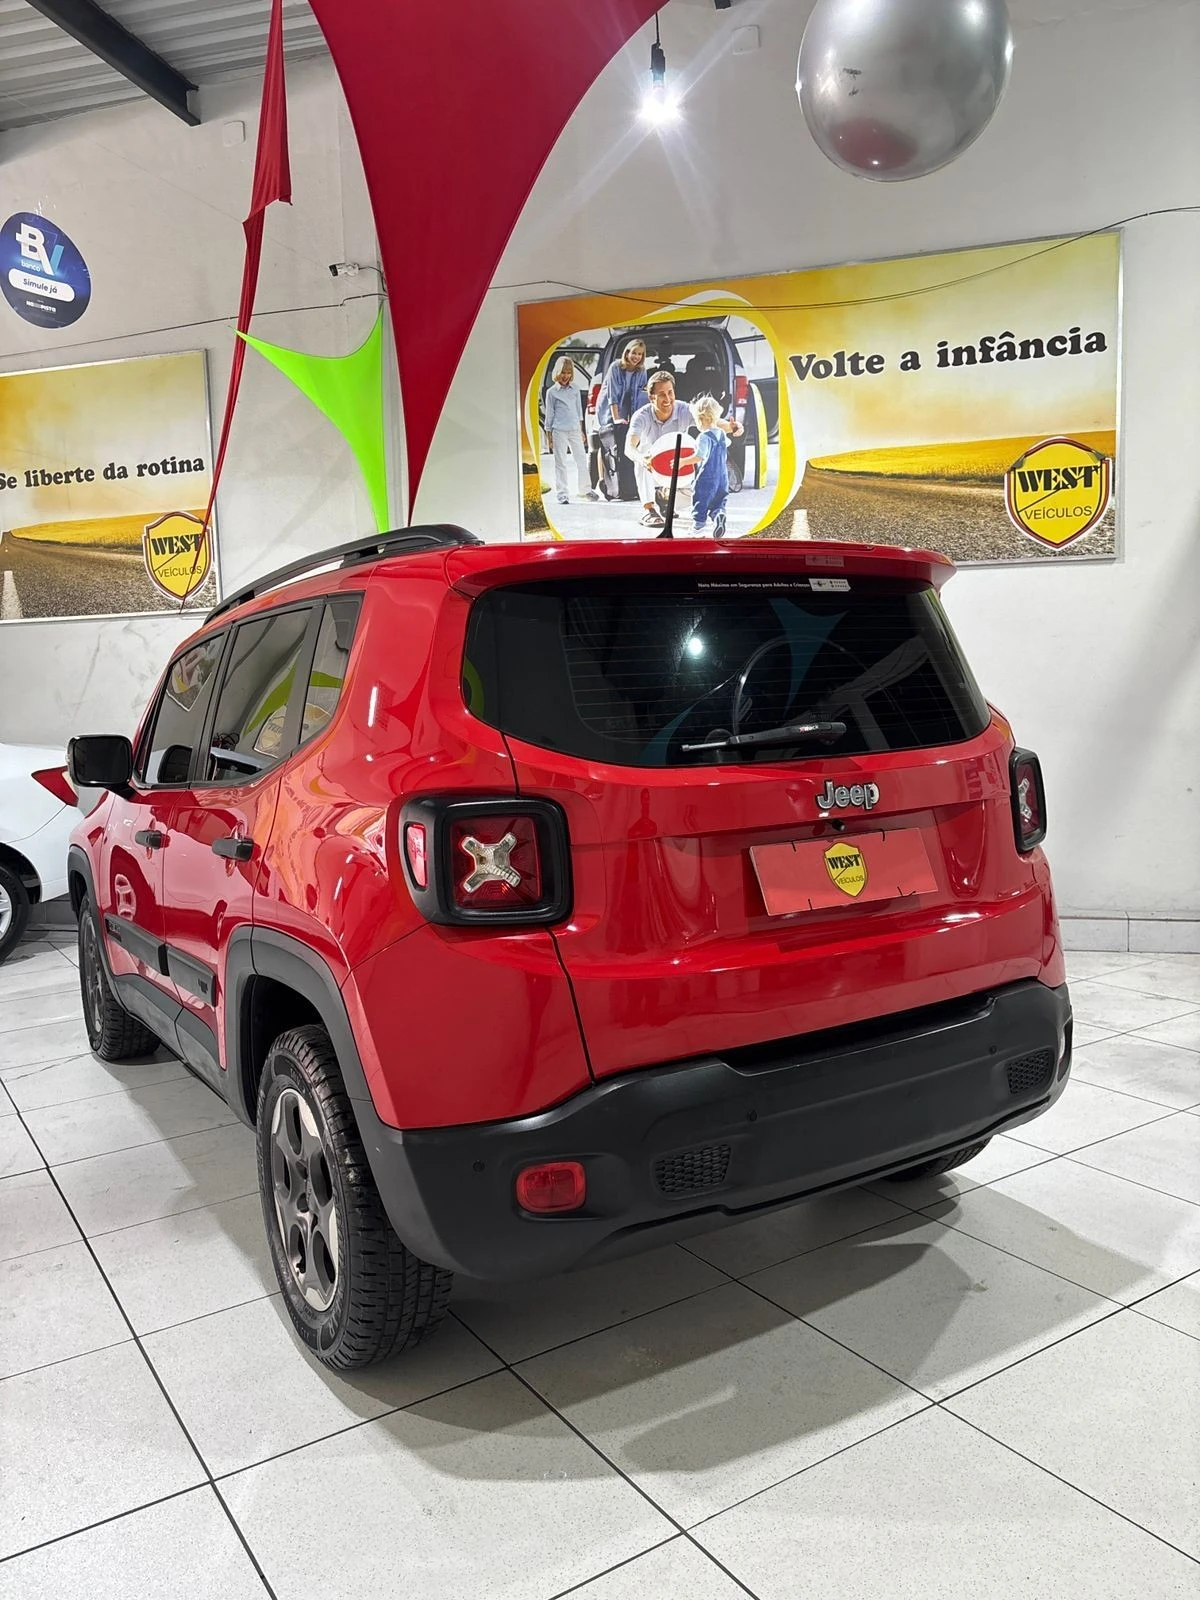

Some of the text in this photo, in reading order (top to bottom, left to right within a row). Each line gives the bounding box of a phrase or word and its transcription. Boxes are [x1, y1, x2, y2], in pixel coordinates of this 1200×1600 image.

[21, 260, 41, 272] banco
[23, 278, 58, 294] Simule já
[789, 327, 1108, 381] Volte a infância
[24, 467, 96, 488] liberte
[103, 462, 129, 480] da
[136, 456, 205, 478] rotina
[1017, 465, 1100, 493] WEST
[1024, 505, 1093, 520] VEÍCULOS
[151, 533, 203, 556] WEST
[158, 565, 202, 578] VEÍCULOS
[816, 780, 880, 810] Jeep
[828, 854, 861, 870] WEST
